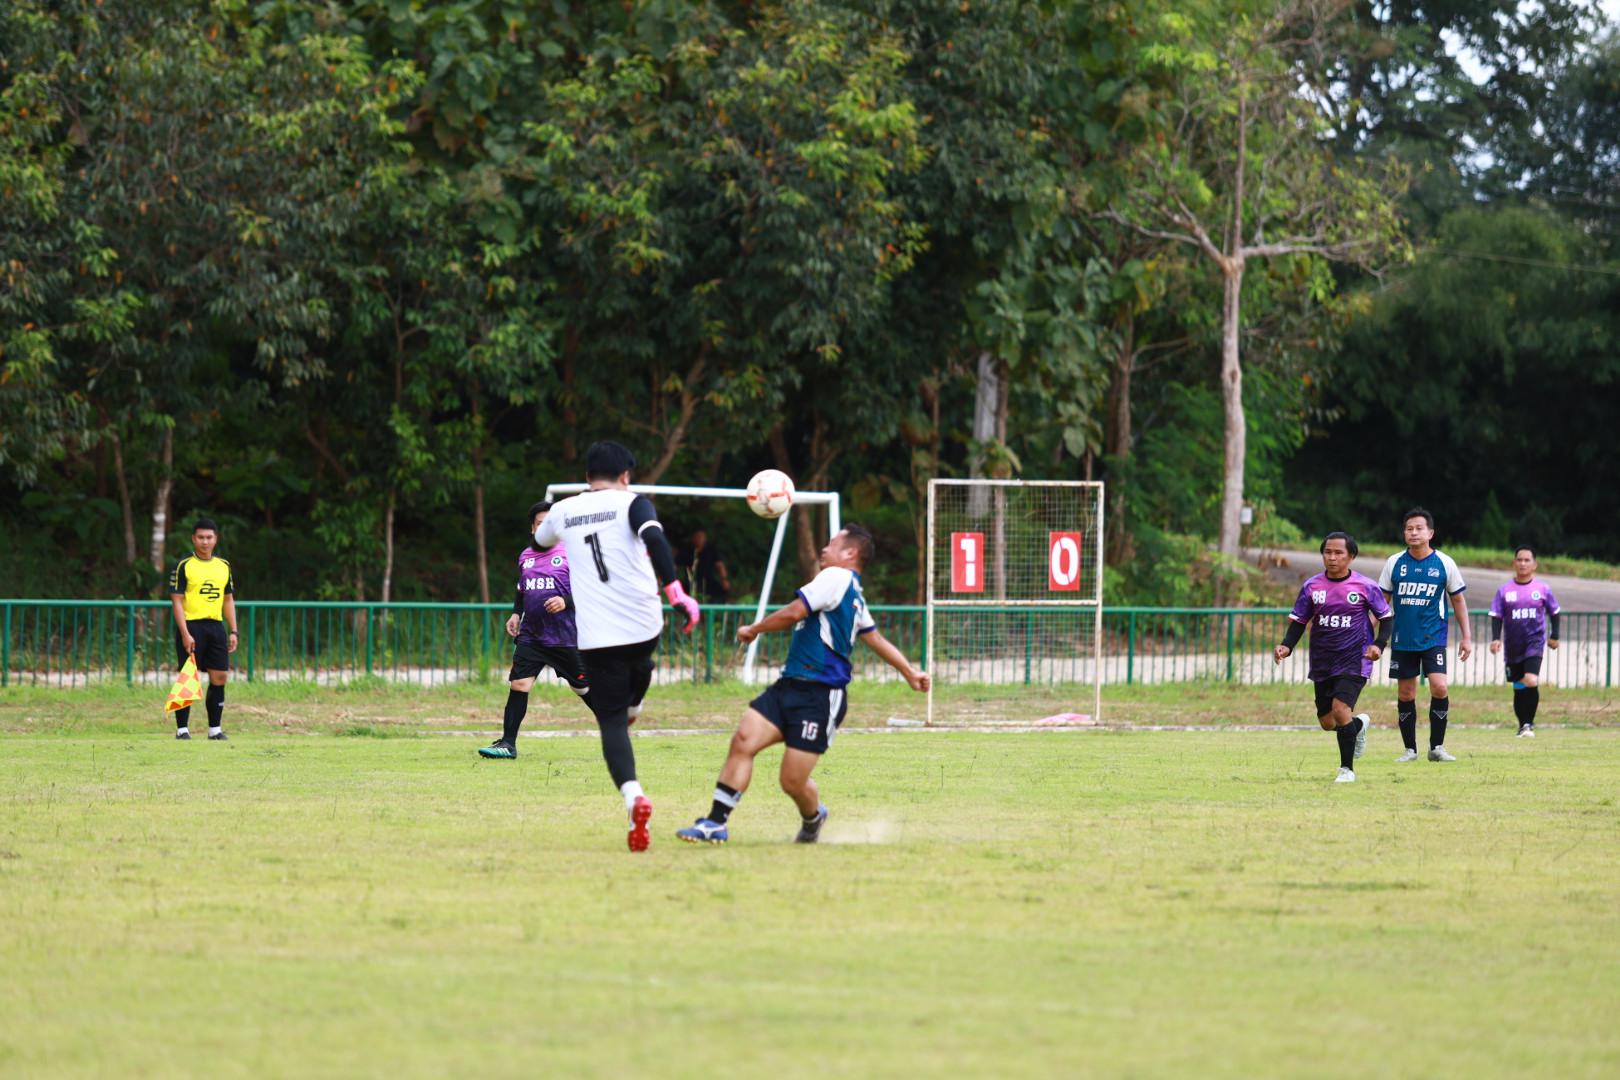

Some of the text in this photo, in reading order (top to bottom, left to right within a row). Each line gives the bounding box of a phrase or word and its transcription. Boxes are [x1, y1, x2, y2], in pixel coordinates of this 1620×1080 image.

[584, 532, 608, 583] 1
[960, 538, 976, 587] 1
[1051, 537, 1079, 586] 0
[1400, 564, 1408, 577] 9
[526, 577, 555, 590] MSH
[1512, 608, 1537, 620] MSH
[1319, 615, 1352, 627] MSH
[1436, 653, 1444, 666] 9
